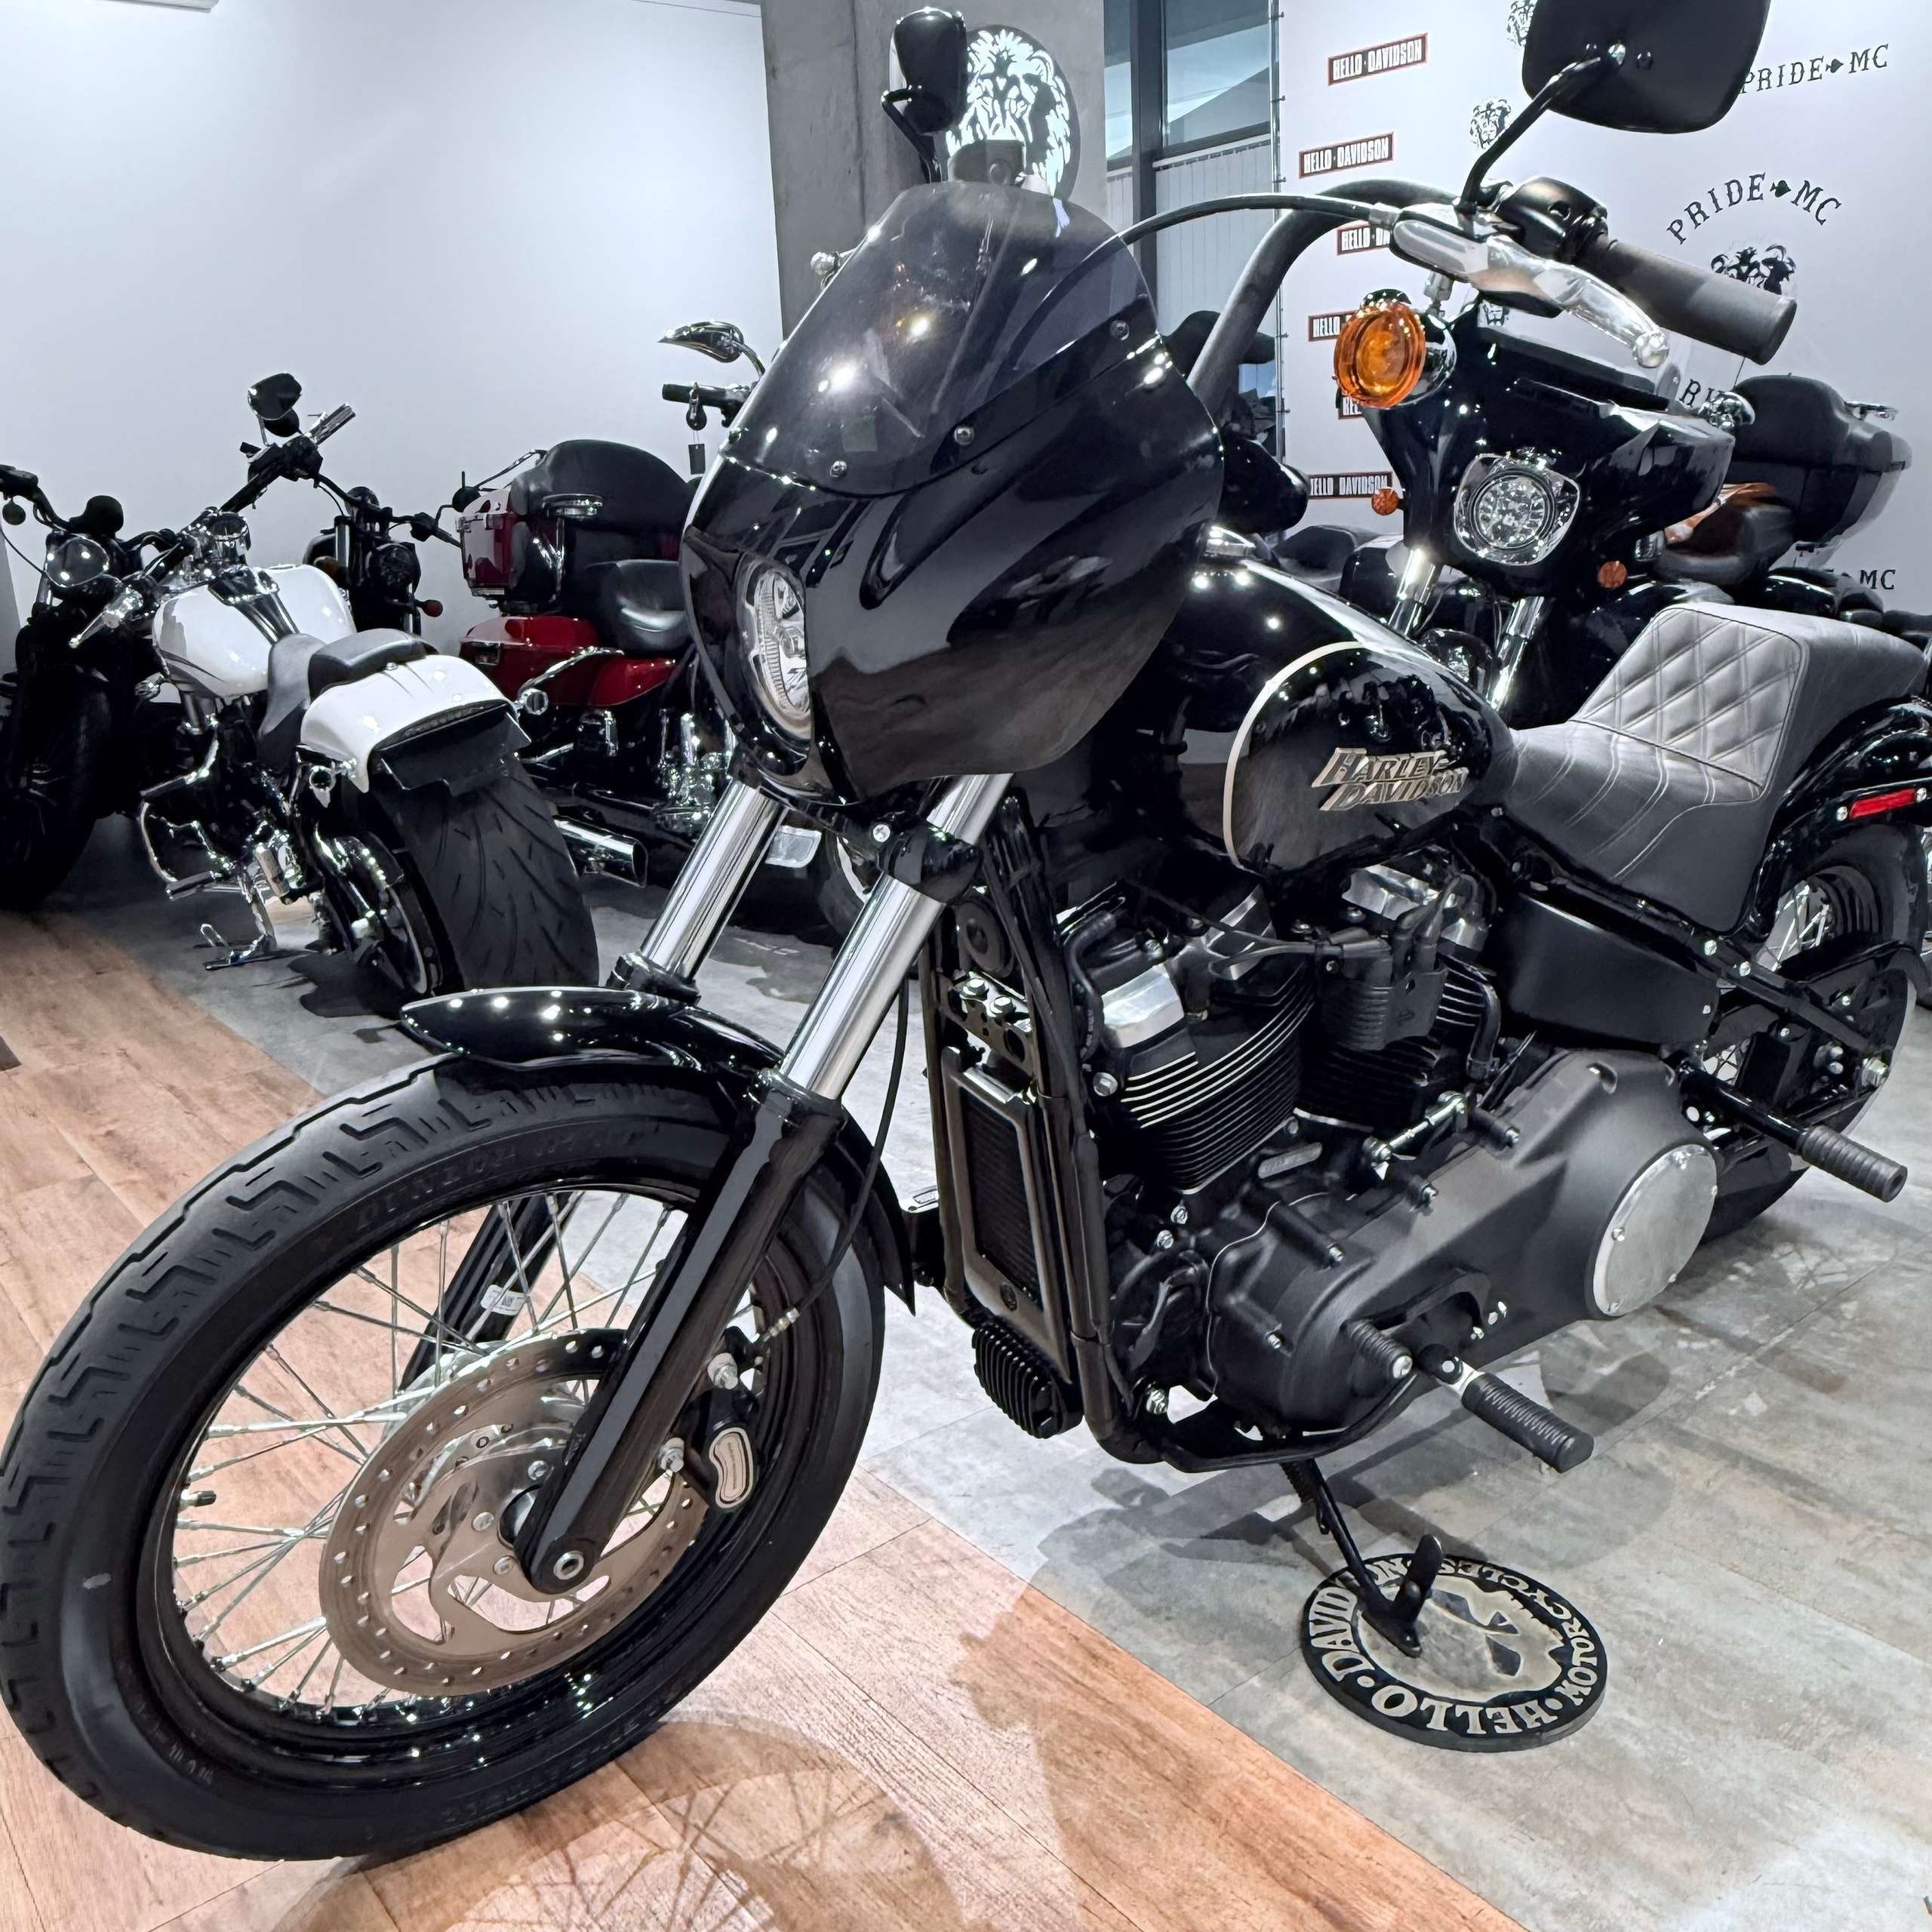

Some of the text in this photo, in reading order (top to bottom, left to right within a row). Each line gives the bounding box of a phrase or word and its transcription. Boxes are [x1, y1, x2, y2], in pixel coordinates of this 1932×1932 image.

[1333, 38, 1422, 81] HELLO DAVIDSON
[1739, 43, 1889, 94] PRIDE MC
[1303, 137, 1389, 174] HELLO DAVIDSON
[1666, 171, 1842, 245] PRIDE MC
[1341, 226, 1371, 251] HELLO
[1312, 315, 1340, 338] HELLO
[1859, 569, 1896, 590] MC
[1311, 746, 1452, 788] HARLEY
[1371, 1684, 1558, 1735] HELLO
